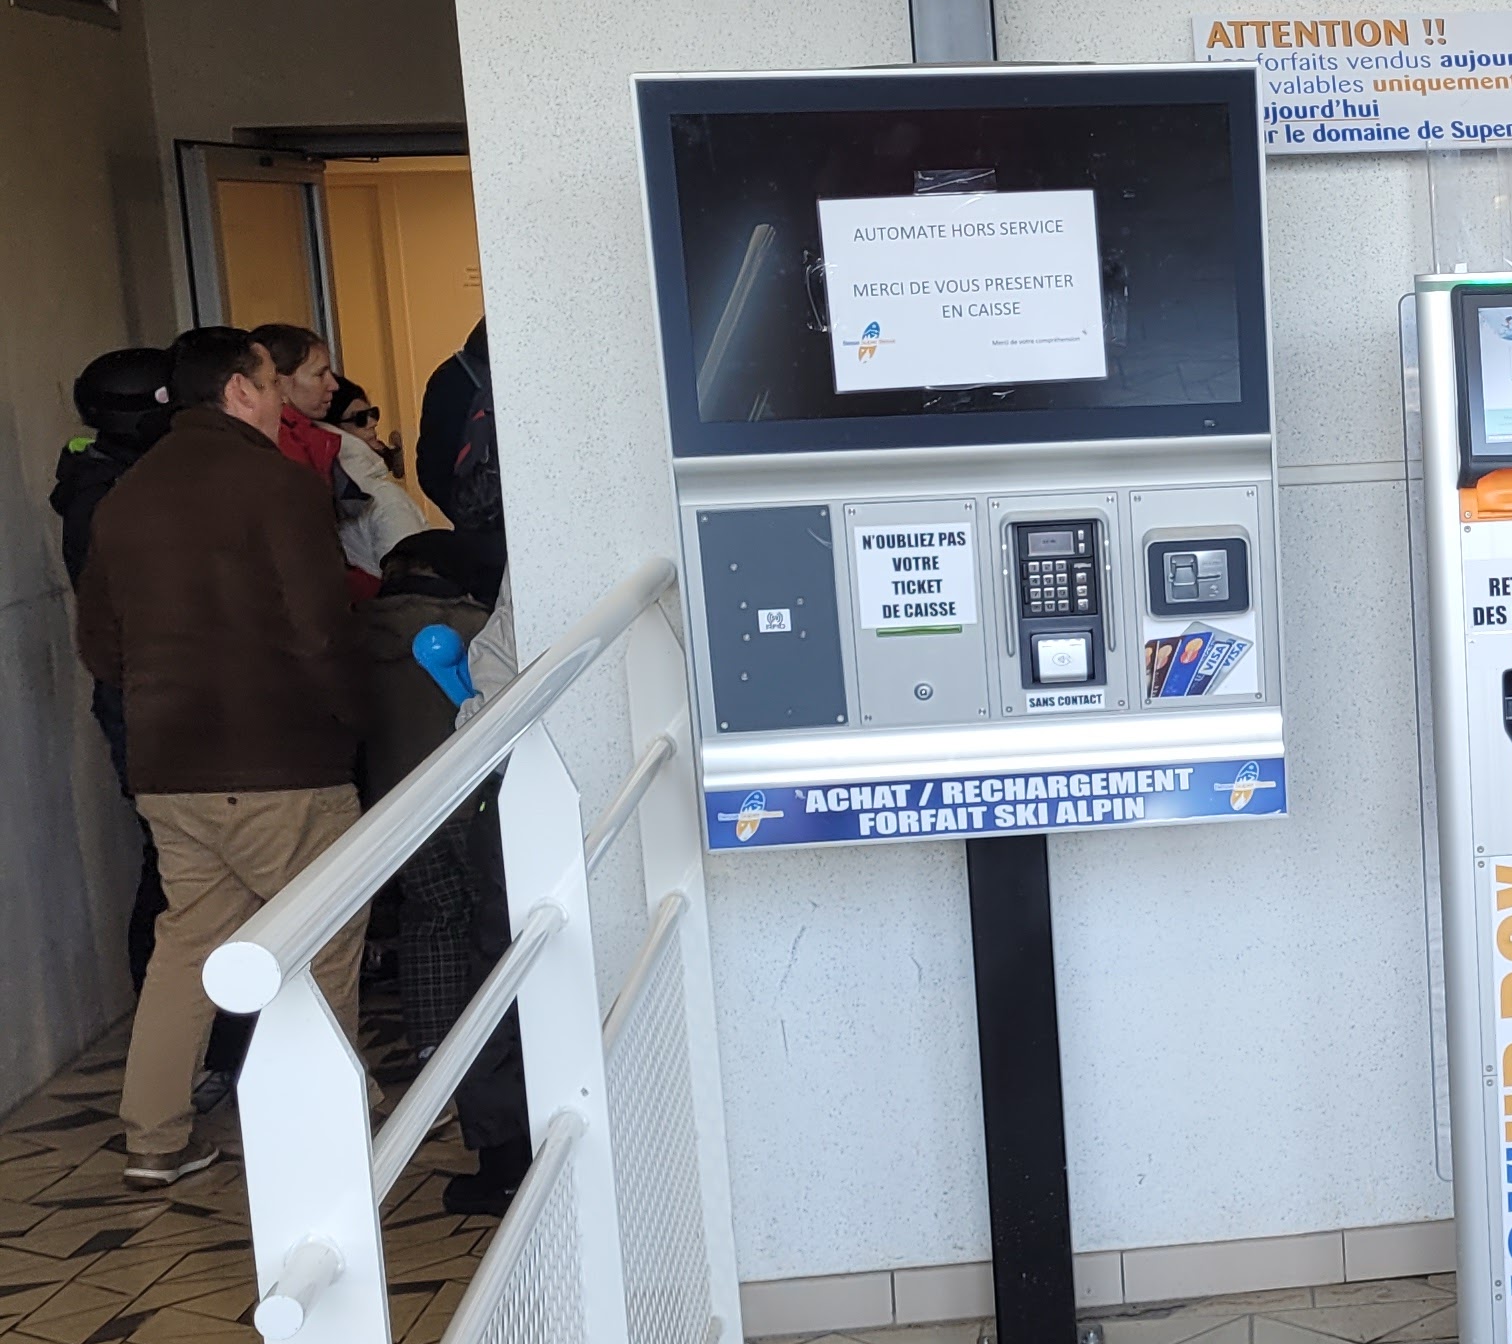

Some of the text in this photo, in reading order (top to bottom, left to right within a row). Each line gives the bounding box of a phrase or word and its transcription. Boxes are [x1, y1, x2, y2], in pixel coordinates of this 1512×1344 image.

[1206, 18, 1447, 49] ATTENTION !!
[1256, 52, 1338, 72] forfaits
[1346, 50, 1431, 70] vendus
[1269, 75, 1364, 95] valables
[1264, 98, 1379, 126] jourd'hui
[1285, 123, 1306, 144] le
[1313, 122, 1410, 143] domaine
[1418, 120, 1444, 140] de
[854, 219, 1064, 242] AUTOMATE HORS SERVICE
[853, 274, 1075, 298] MERCI DE VOUS PRESENTER
[941, 301, 1021, 319] EN CAISSE
[862, 531, 967, 550] N'OUBLIEZ PAS
[892, 555, 940, 572] VOTRE
[891, 578, 943, 596] TICKET
[882, 601, 957, 620] DE CAISSE
[1472, 605, 1508, 626] DES
[1205, 645, 1227, 671] VISA
[1222, 641, 1248, 667] VISA
[1028, 693, 1103, 709] SANS CONTACT
[805, 784, 912, 814] ACHAT
[941, 767, 1194, 805] RECHARGEMENT
[858, 796, 1146, 837] FORFAIT SKI ALPIN
